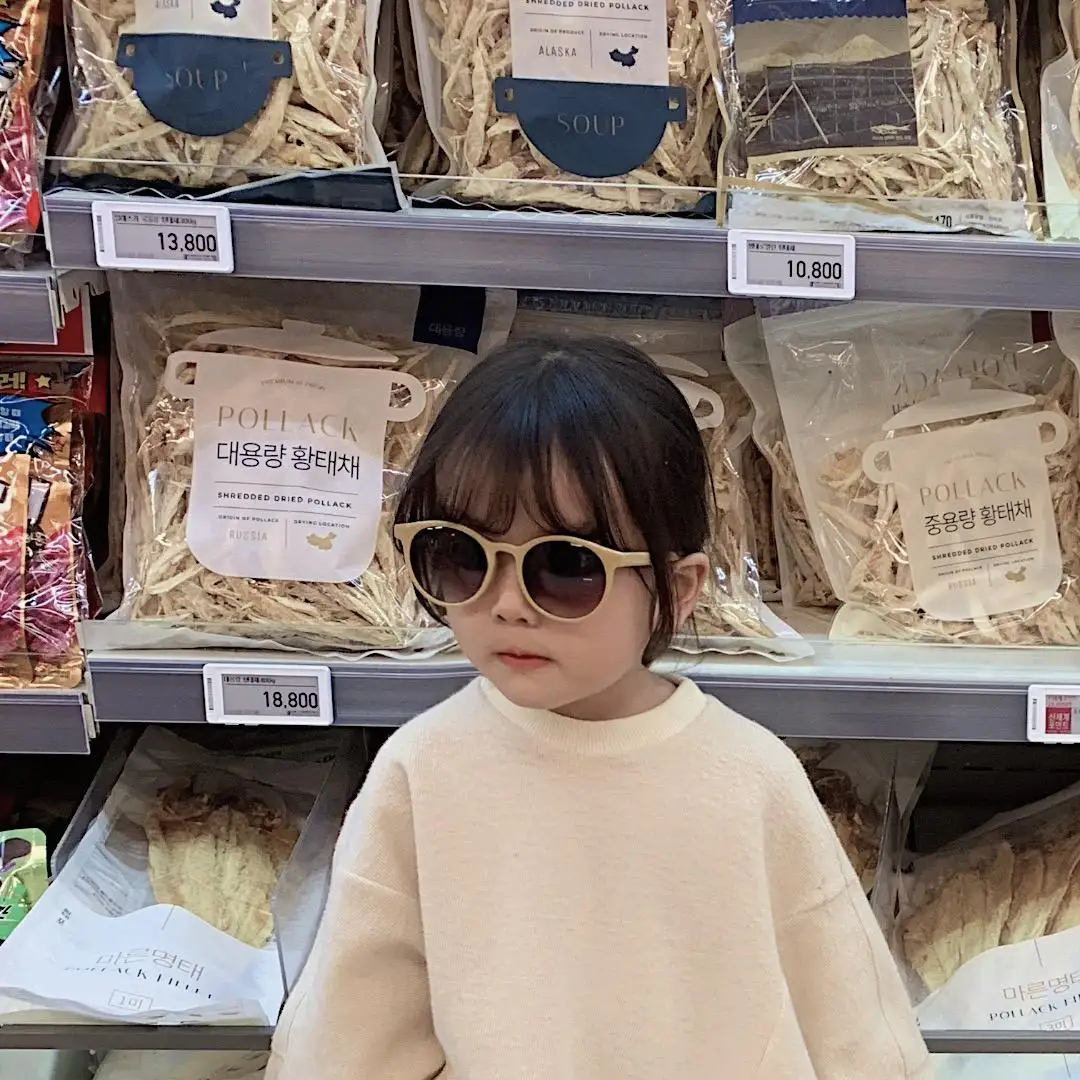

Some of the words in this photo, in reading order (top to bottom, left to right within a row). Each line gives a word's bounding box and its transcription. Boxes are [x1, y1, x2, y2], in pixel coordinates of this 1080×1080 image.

[577, 1, 606, 9] DRIED
[609, 2, 650, 11] POLLACK
[538, 45, 577, 57] ALASKA
[557, 113, 625, 136] SOUP
[157, 231, 218, 253] 13,800
[786, 259, 842, 280] 10,800
[216, 405, 359, 442] POLLACK
[216, 441, 287, 470] 대용량
[291, 445, 360, 480] 황태채
[919, 471, 1027, 506] POLLACK
[217, 491, 270, 502] SHREDDED
[274, 494, 304, 504] DRIED
[307, 497, 352, 509] POLLACK
[924, 507, 976, 537] 중용량
[980, 498, 1033, 527] 황태채
[228, 529, 268, 542] RUSSIA
[932, 549, 973, 561] SHREDDED
[974, 544, 998, 554] DRIED
[1000, 538, 1034, 550] POLLACK
[263, 690, 319, 709] 18,800
[989, 1003, 1058, 1022] POLLACK
